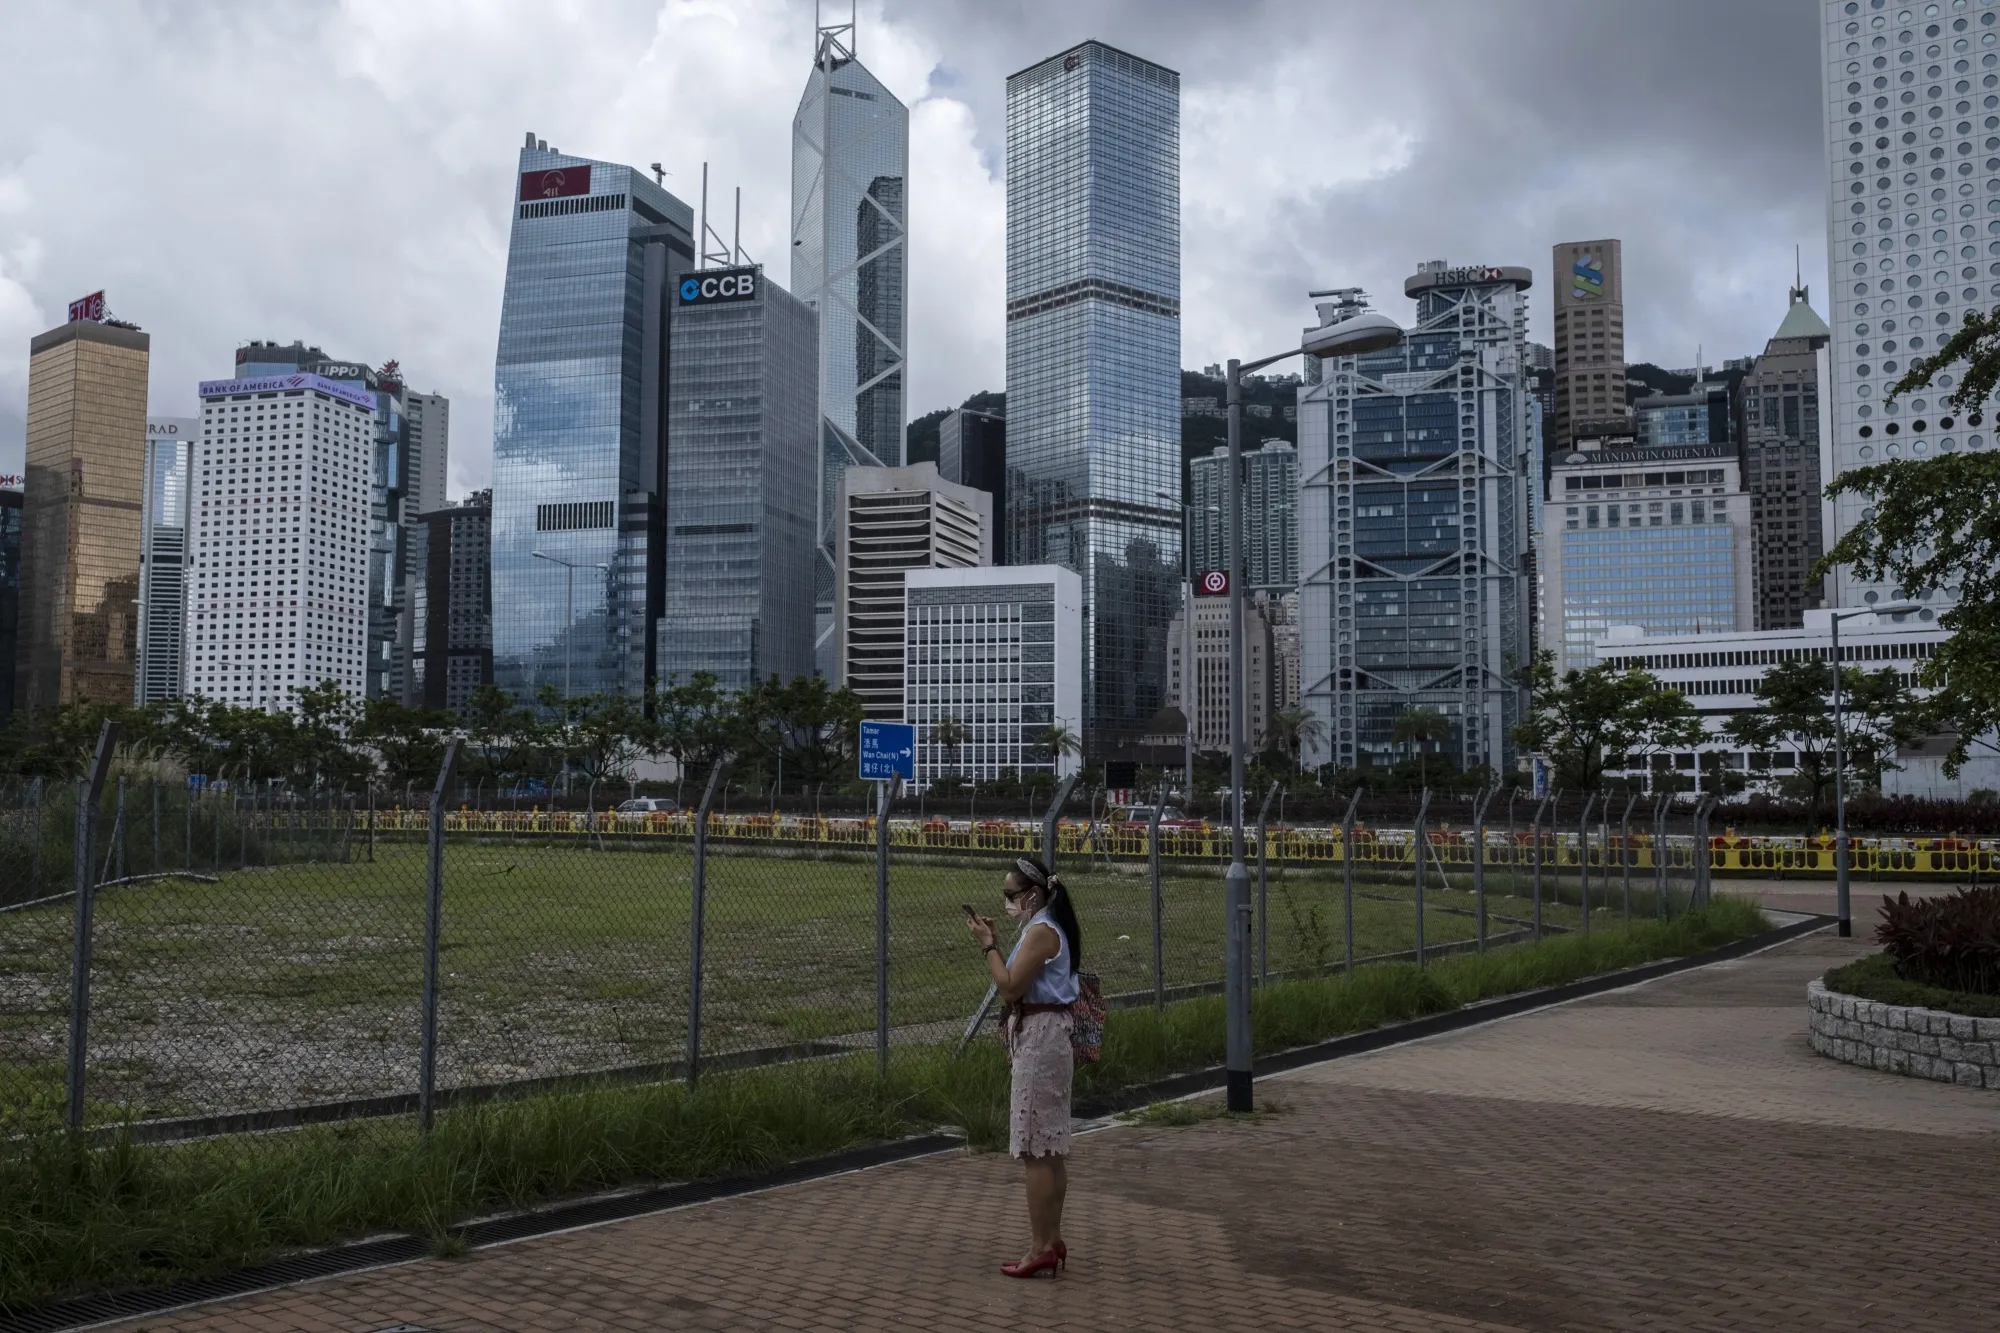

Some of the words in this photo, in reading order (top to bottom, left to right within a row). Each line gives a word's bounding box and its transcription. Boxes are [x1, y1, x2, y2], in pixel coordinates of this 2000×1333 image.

[1435, 269, 1478, 285] HSBC
[701, 274, 754, 298] CCB
[316, 366, 359, 377] LIPPO
[203, 386, 227, 395] BANK
[229, 384, 241, 393] OF
[243, 381, 284, 391] AMERICA
[317, 382, 331, 391] BANK
[339, 389, 360, 401] AMERICA
[1591, 450, 1658, 463] MANDARIN
[1661, 446, 1725, 459] ORIENTAL
[863, 726, 879, 734] Tamar
[864, 738, 879, 749] 添馬
[863, 750, 875, 758] Wan
[876, 751, 899, 761] Chai(N)
